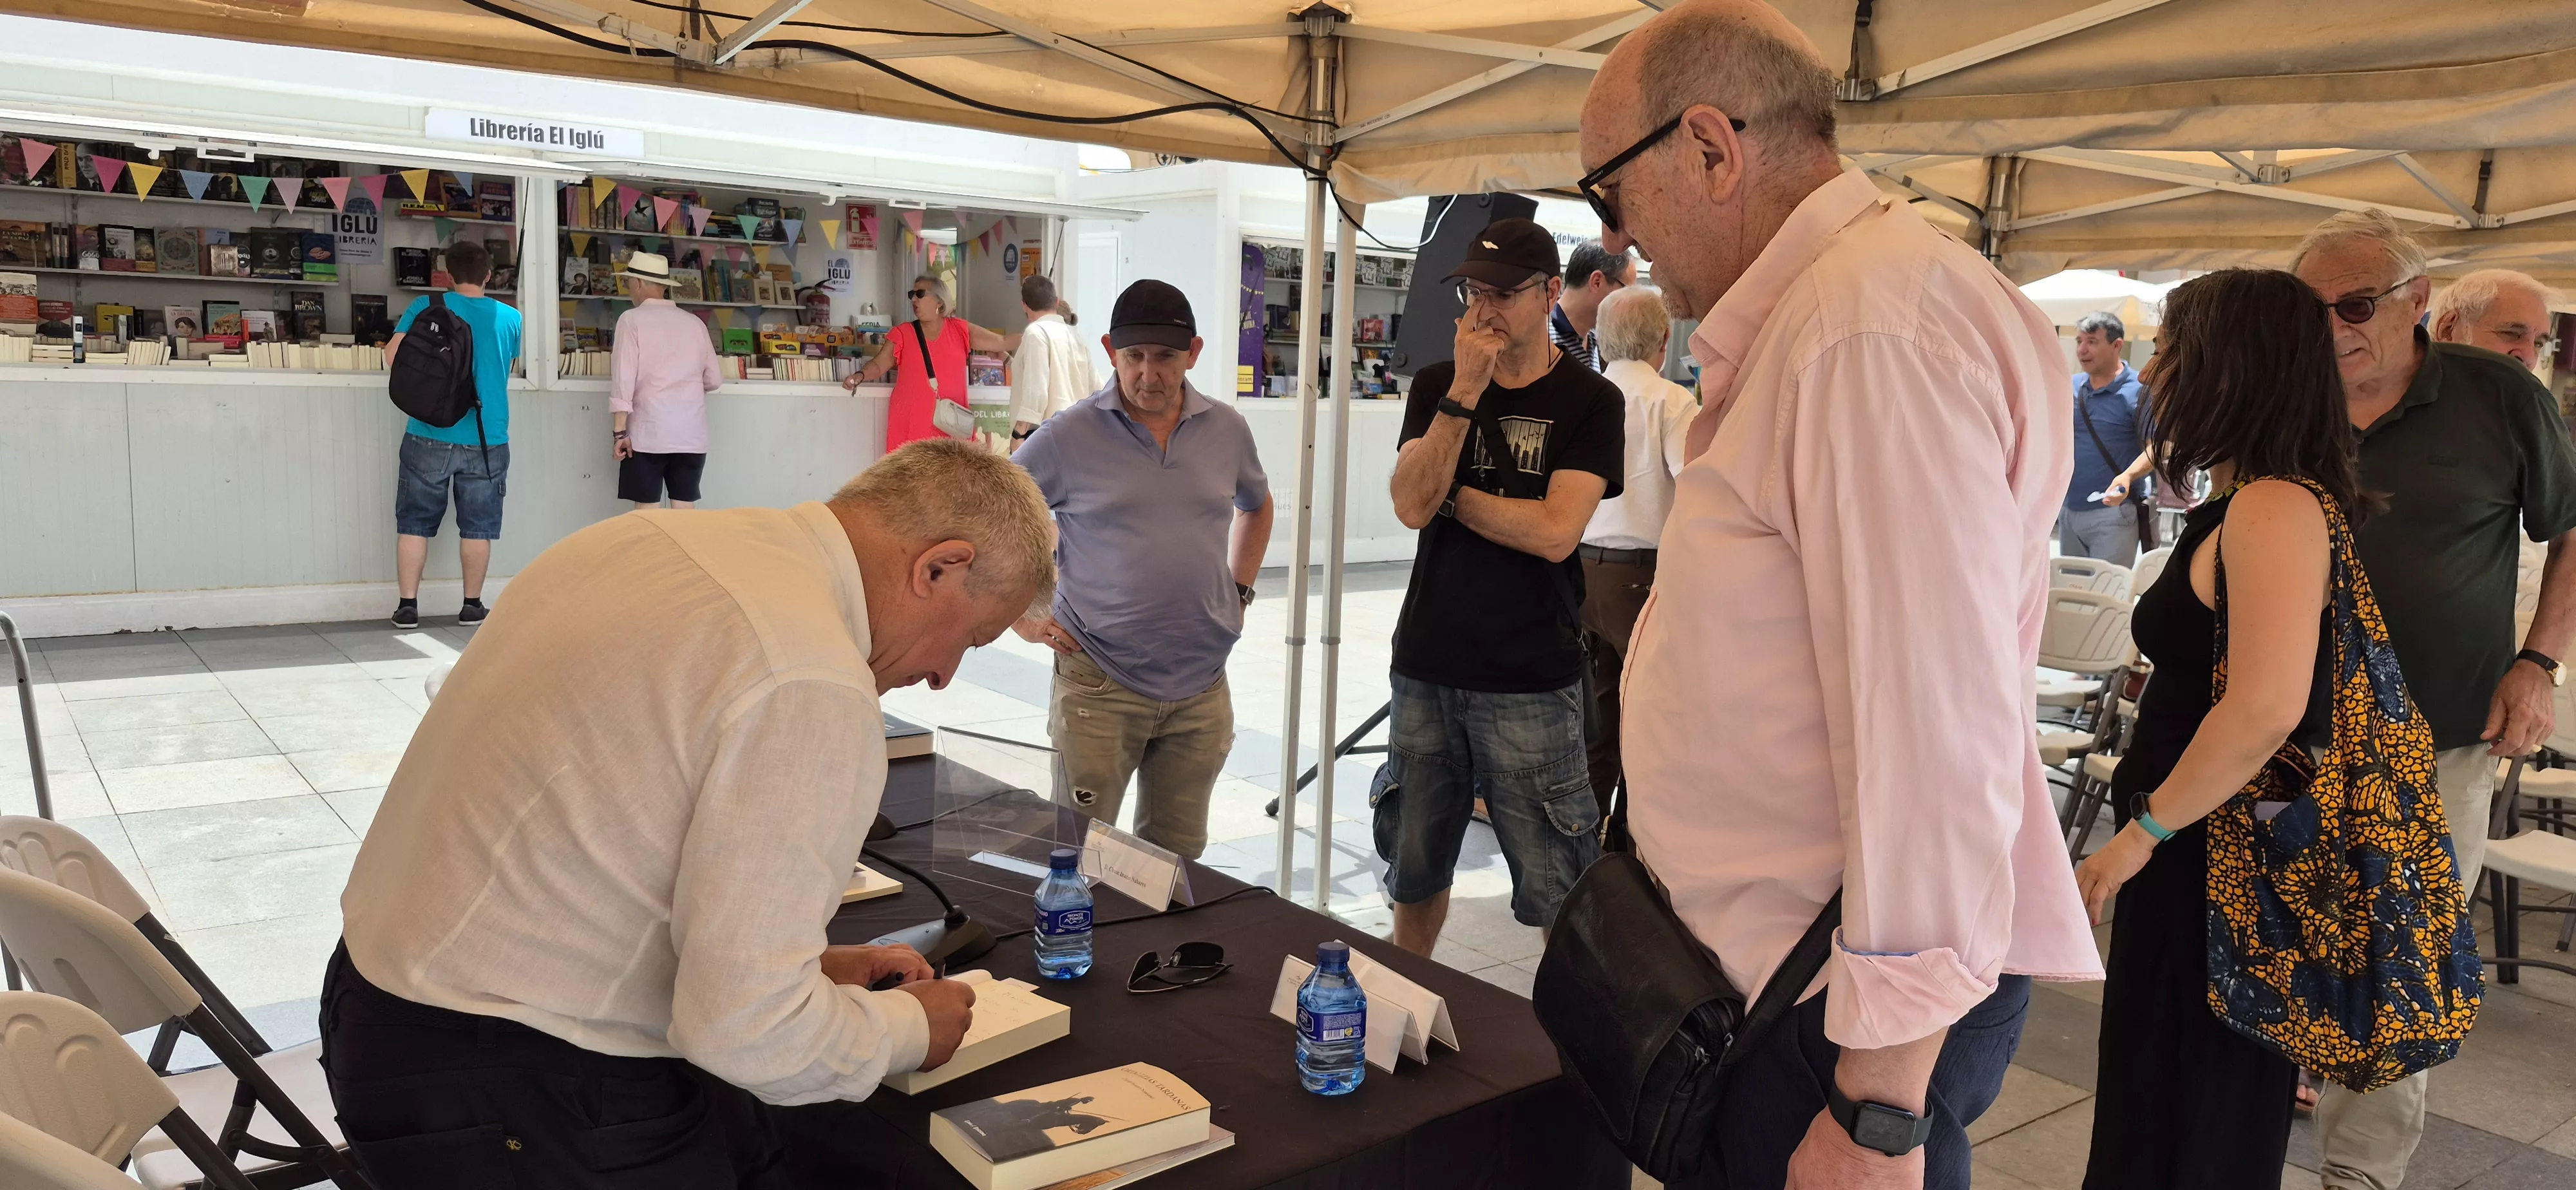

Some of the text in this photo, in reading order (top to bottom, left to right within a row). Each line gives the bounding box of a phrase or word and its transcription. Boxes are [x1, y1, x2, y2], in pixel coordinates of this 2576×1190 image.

[470, 117, 605, 149] Librería El Iglú
[332, 213, 377, 234] IGLÚ
[339, 234, 377, 245] IBRERÍA
